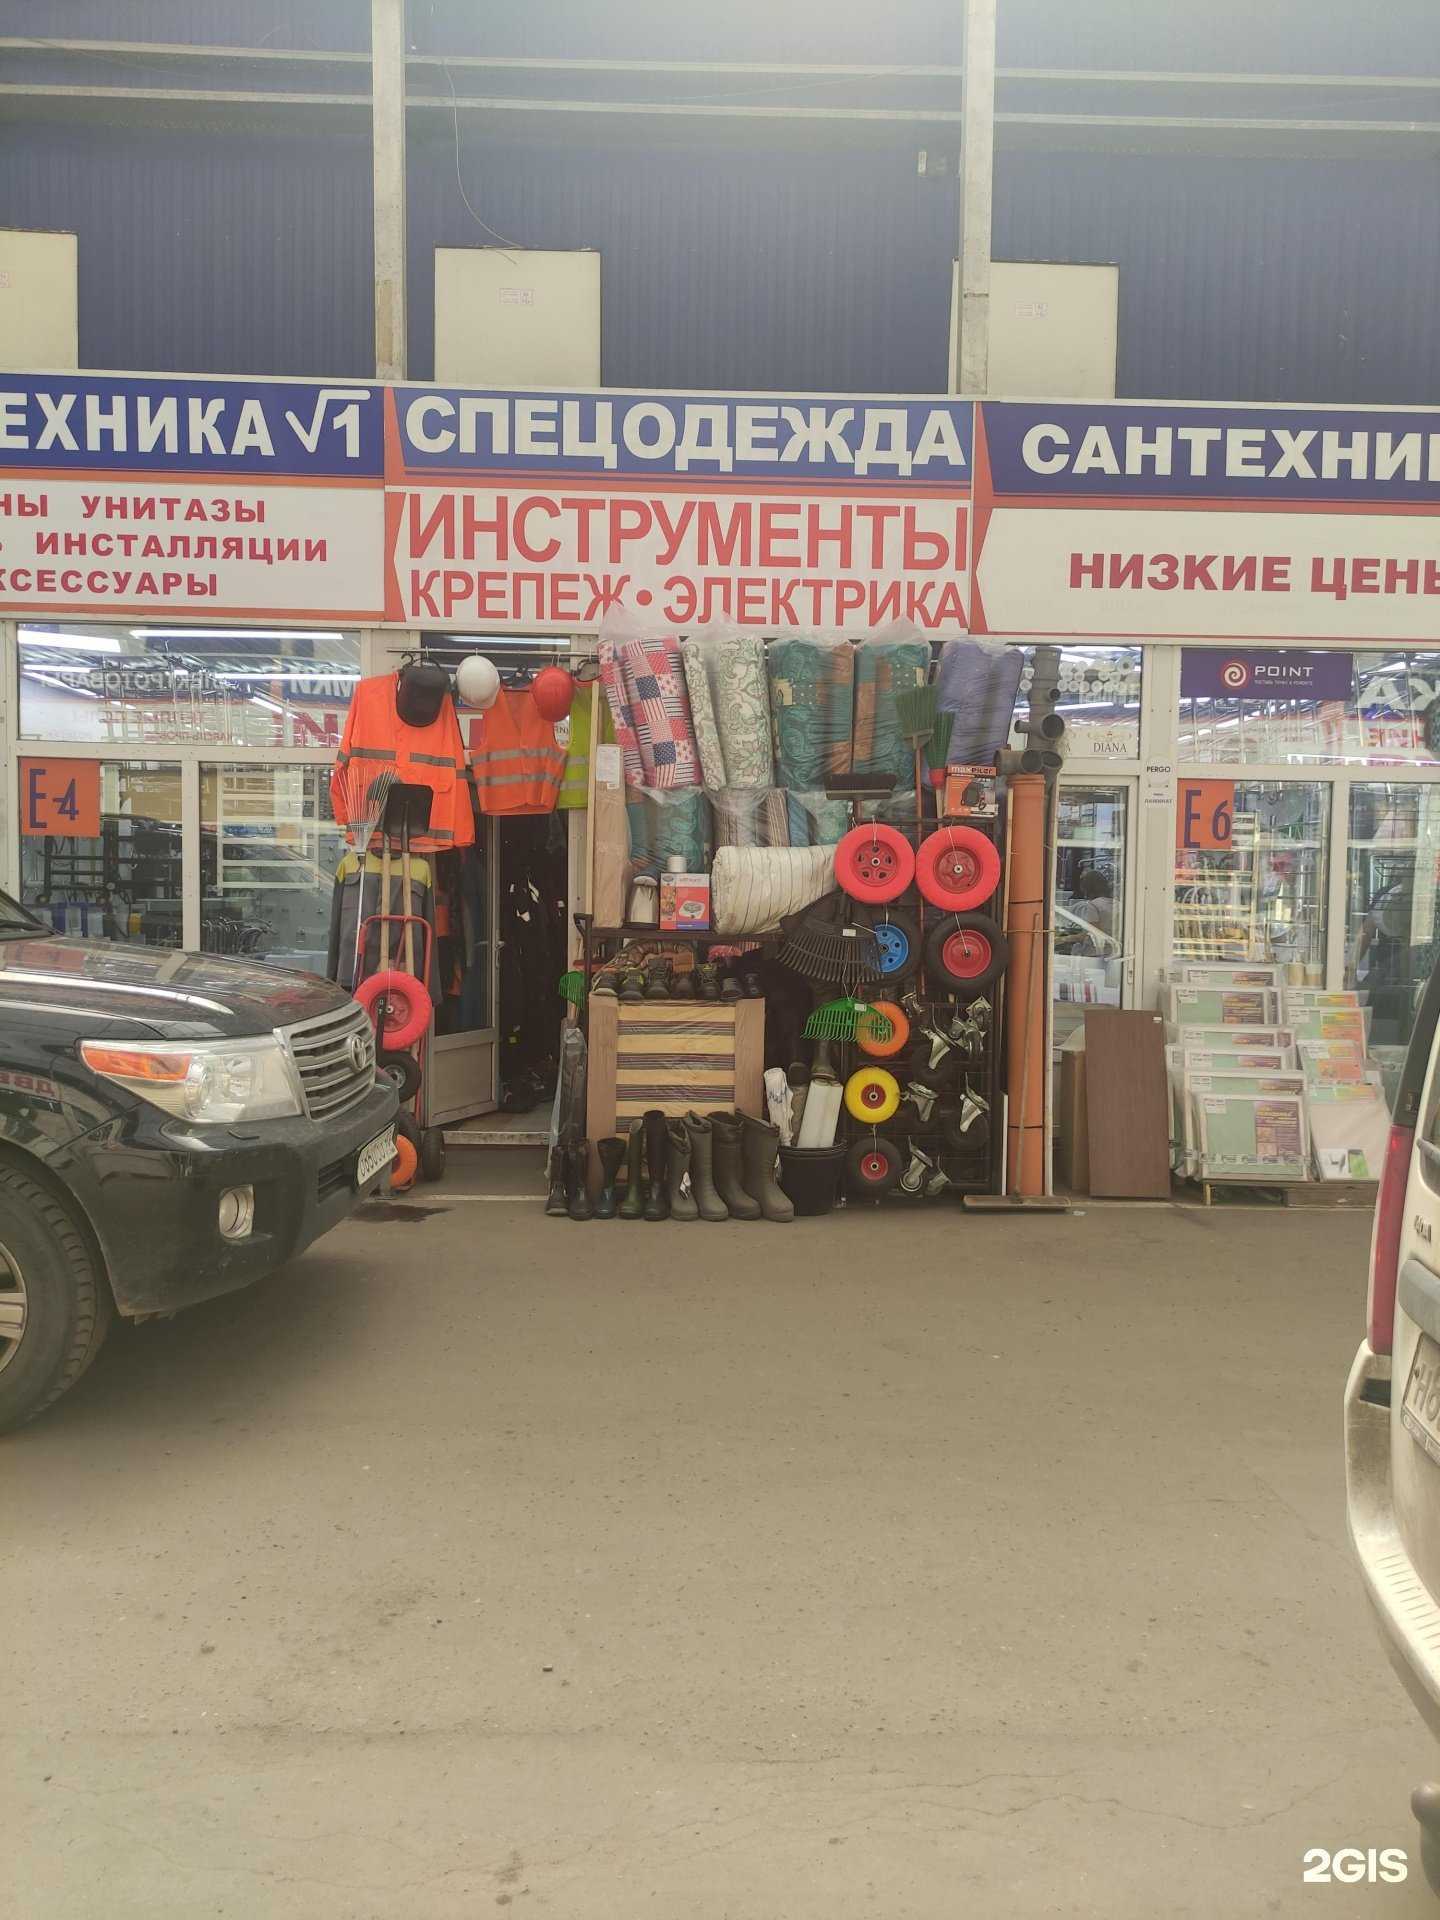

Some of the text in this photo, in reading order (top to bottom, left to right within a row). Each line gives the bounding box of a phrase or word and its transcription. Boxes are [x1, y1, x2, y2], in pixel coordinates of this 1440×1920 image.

[0, 392, 275, 457] ЕХНИКА
[405, 395, 967, 476] СПЕЦОДЕЖДА
[81, 495, 266, 523] УНИТАЗЫ
[36, 532, 328, 565] ИНСТАЛЛЯЦИИ
[409, 493, 968, 571] ИНСТРУМЕНТЫ
[1069, 553, 1291, 592] НИЗКИЕ
[1254, 665, 1315, 678] POINT
[1093, 742, 1128, 753] DIANA
[1146, 765, 1171, 773] PERGO
